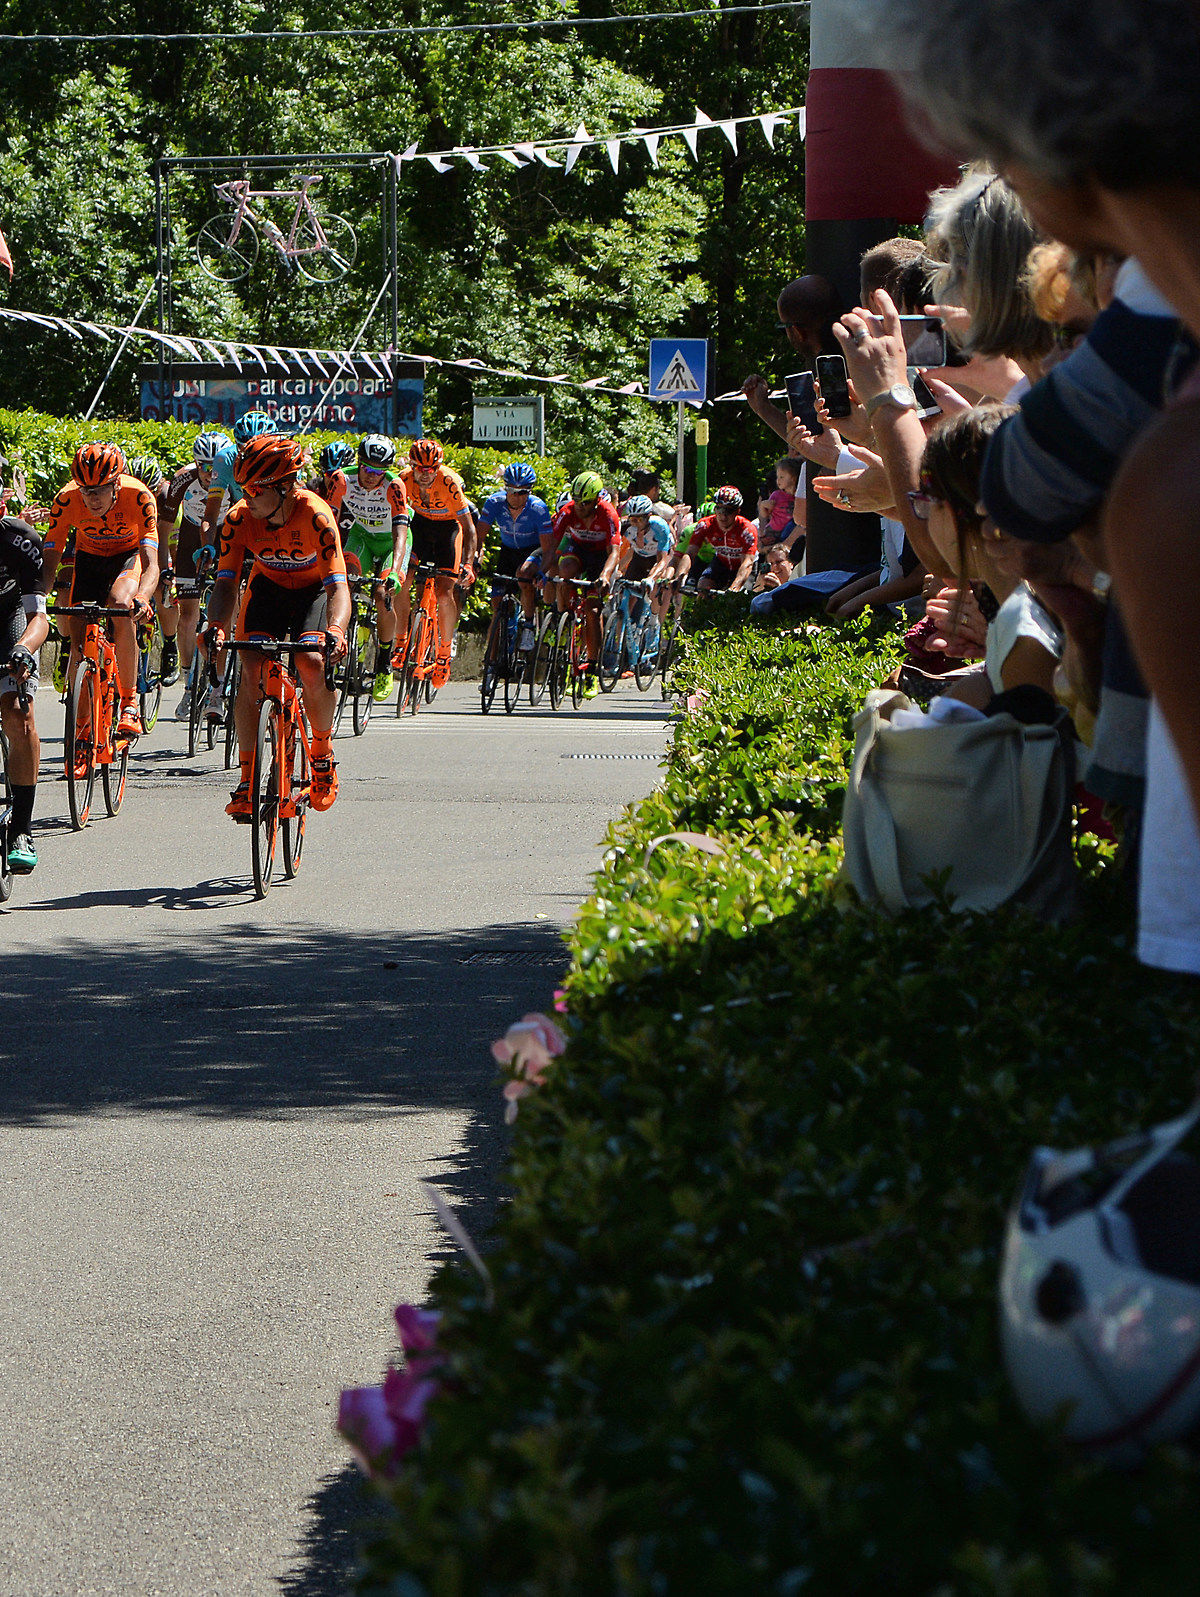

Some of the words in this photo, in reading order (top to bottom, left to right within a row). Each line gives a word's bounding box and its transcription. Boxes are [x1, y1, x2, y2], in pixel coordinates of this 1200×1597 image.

[266, 400, 356, 429] Bergamo
[495, 410, 515, 418] VIA
[477, 425, 491, 437] AL
[495, 425, 533, 437] PORTO
[312, 512, 338, 561] CCC
[12, 534, 44, 570] BORA
[259, 548, 308, 562] CCC
